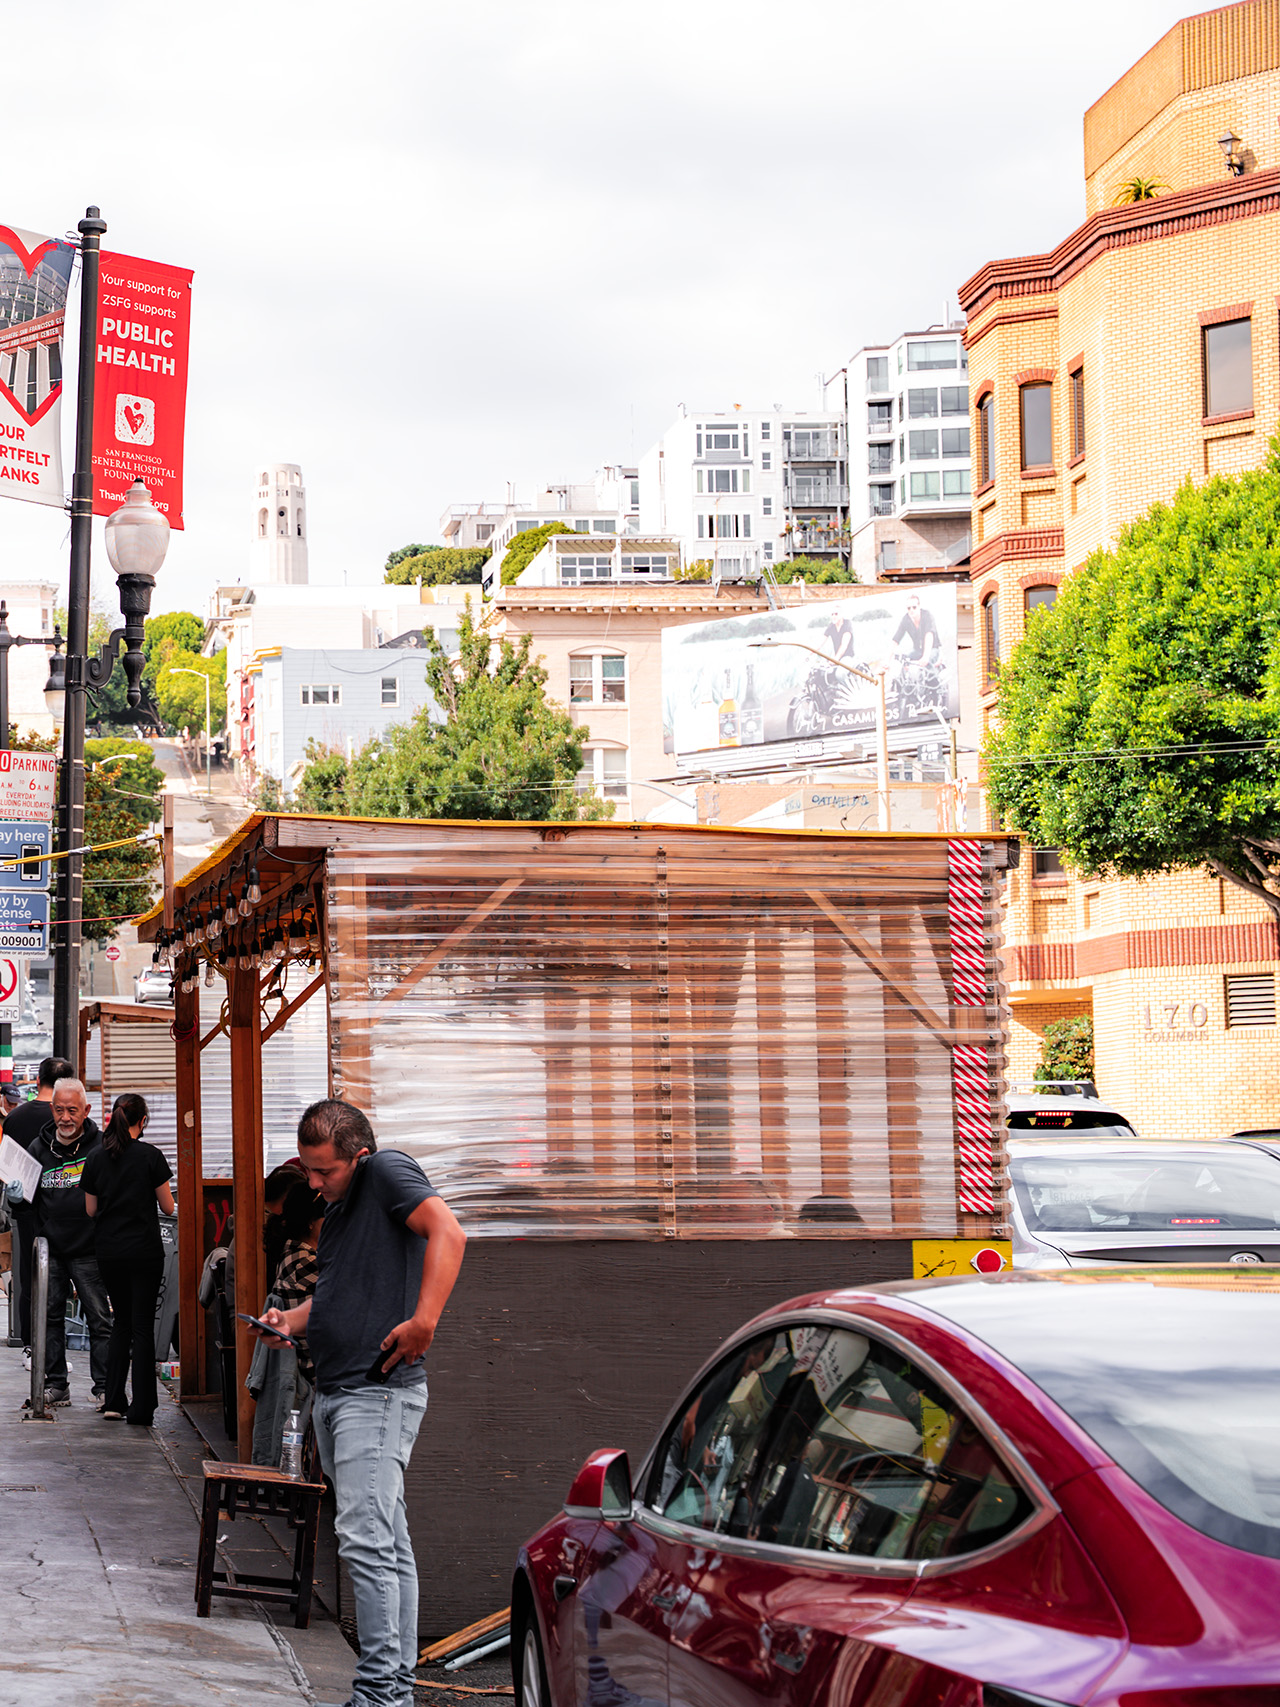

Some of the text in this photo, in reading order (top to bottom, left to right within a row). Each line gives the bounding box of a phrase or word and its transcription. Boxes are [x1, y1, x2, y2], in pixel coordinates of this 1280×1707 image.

[101, 272, 182, 299] Your support for
[102, 294, 177, 319] ZSFG supports
[102, 317, 174, 348] PUBLIC
[97, 344, 176, 377] HEALTH
[105, 448, 162, 465] SAN FRANCISCO
[91, 455, 176, 479] GENERAL HOSPITAL
[832, 708, 900, 726] CASAMIOS
[12, 758, 55, 773] PARKING
[1, 782, 15, 790] A.M.
[29, 778, 37, 791] 6
[6, 791, 36, 800] EVERYDAY
[22, 800, 50, 809] HOLIDAYS
[17, 809, 48, 818] CLEANING
[15, 829, 45, 842] here
[13, 895, 29, 909] by
[1144, 1003, 1208, 1030] 170
[1144, 1030, 1209, 1043] COLUMBUS
